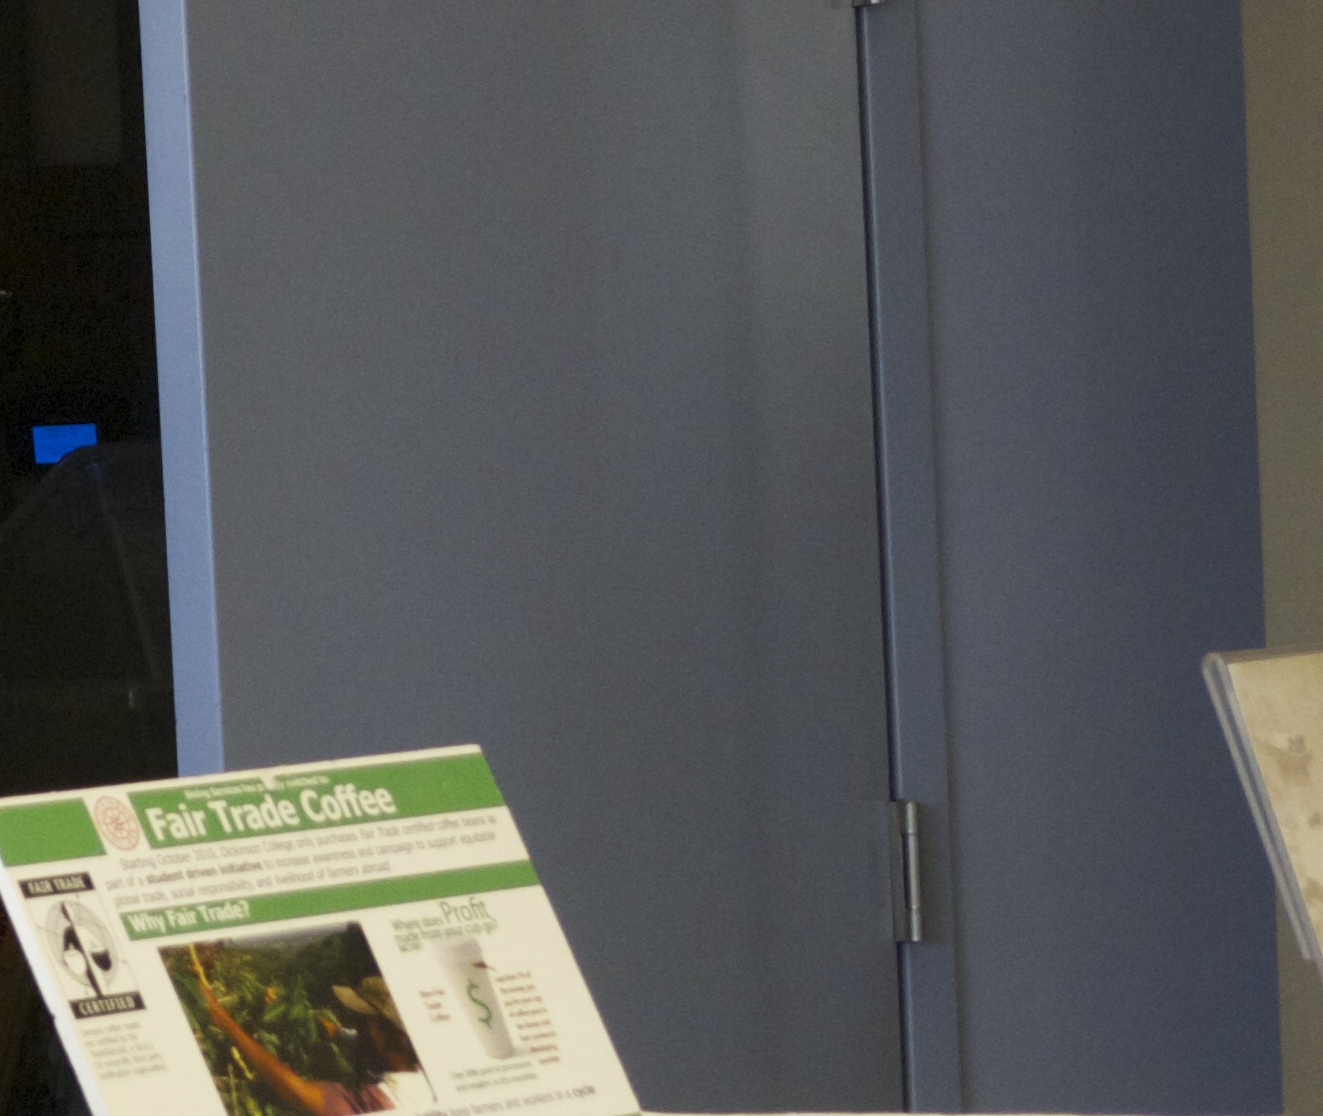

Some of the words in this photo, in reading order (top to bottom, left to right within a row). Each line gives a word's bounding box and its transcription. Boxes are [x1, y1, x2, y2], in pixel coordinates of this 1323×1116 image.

[145, 803, 212, 841] Fair
[207, 792, 300, 833] Trade
[297, 781, 396, 823] Coffee
[146, 871, 183, 882] student
[185, 866, 216, 877] driven
[219, 860, 260, 873] initiative
[27, 881, 52, 894] FAIR
[54, 877, 84, 890] TRADE
[128, 912, 167, 935] Why
[165, 907, 199, 927] Fair
[196, 900, 253, 923] Trade?
[440, 897, 489, 923] Profit
[79, 997, 134, 1014] CERTIFIED
